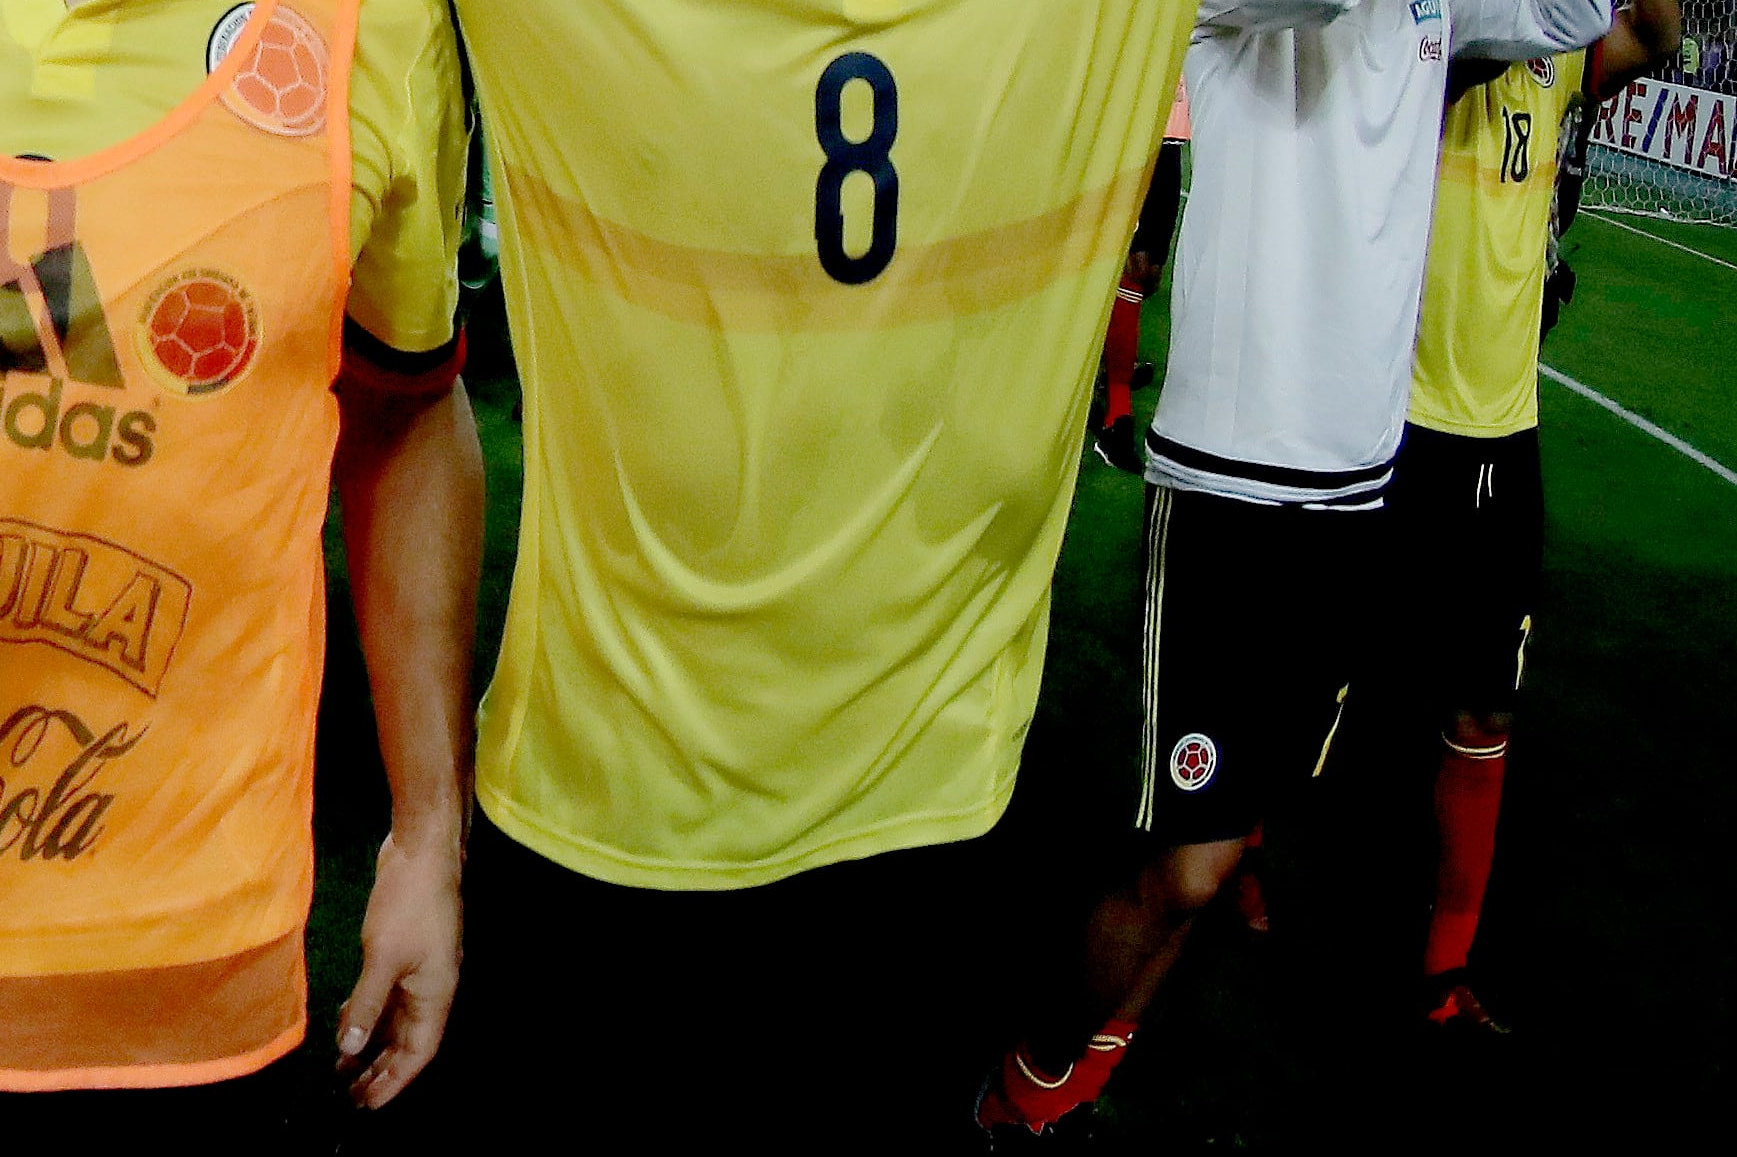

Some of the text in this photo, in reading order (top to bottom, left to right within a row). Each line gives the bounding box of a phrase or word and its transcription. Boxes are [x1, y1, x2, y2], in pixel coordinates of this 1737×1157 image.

[815, 51, 900, 285] 8
[1499, 104, 1532, 184] 18
[1593, 81, 1737, 178] RE/MA
